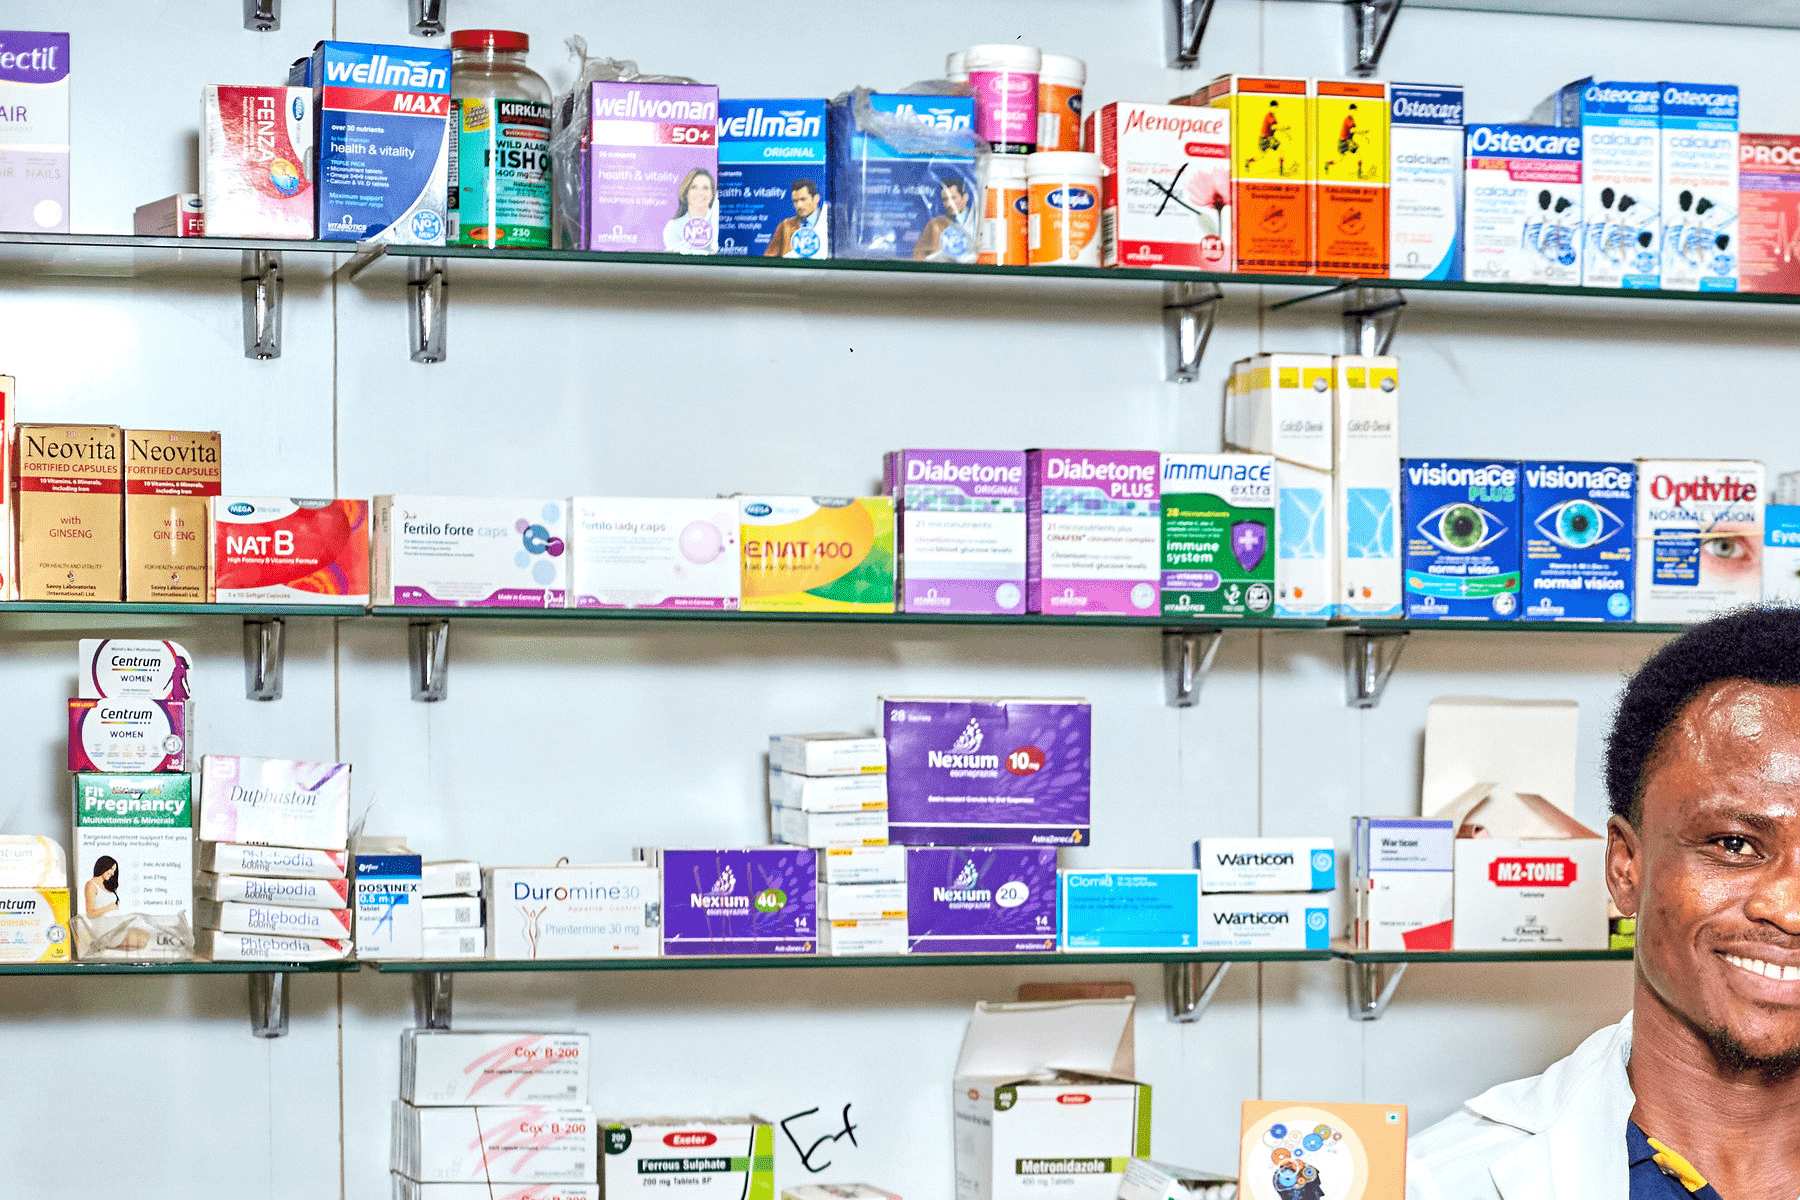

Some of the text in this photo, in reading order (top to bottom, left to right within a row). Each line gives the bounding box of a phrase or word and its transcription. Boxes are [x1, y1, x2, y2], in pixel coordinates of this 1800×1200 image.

[327, 54, 447, 90] wellman
[393, 92, 444, 114] MAX
[1663, 87, 1738, 107] Osteocare
[501, 103, 553, 118] KIRKLAN
[594, 91, 716, 121] wellwoman
[1393, 98, 1462, 121] Osteocare
[258, 95, 276, 162] FENZA
[1124, 109, 1223, 136] Menopace
[671, 127, 711, 143] 50+
[1471, 126, 1580, 157] Osteocare
[330, 140, 415, 160] health & vitality
[497, 140, 521, 150] WILD
[763, 147, 815, 158] ORIGINAL
[1396, 153, 1451, 168] calcium
[26, 435, 116, 463] Neovita
[131, 438, 217, 465] Neovita
[23, 463, 118, 475] FORTIFIED CAPSULES
[127, 465, 220, 478] FORTIFIED CAPSULES
[908, 460, 1022, 484] Diabetone
[1047, 458, 1156, 483] Diabetone
[1164, 457, 1271, 483] immunace
[1409, 464, 1516, 487] visionace
[1527, 465, 1632, 489] visionace
[1110, 483, 1154, 499] PLUS
[1230, 482, 1271, 498] extra
[1650, 474, 1757, 505] Optivite
[60, 515, 82, 527] with
[1649, 510, 1755, 523] NORMAL VISION
[49, 528, 93, 540] GINSENG
[153, 529, 196, 541] GINSENG
[403, 521, 508, 540] fertilo forte caps
[226, 530, 294, 556] NAT B
[812, 542, 852, 560] 400
[1166, 541, 1219, 554] immune
[1166, 551, 1214, 567] system
[1428, 563, 1500, 576] normal vision
[1533, 577, 1625, 591] normal vision
[111, 655, 161, 669] Centrum
[120, 675, 153, 683] WOMEN
[100, 708, 153, 722] Centrum
[109, 730, 144, 739] WOMEN
[84, 797, 187, 817] Pregnancy
[1216, 850, 1295, 869] Warticon
[1498, 863, 1565, 882] M2-TONE
[245, 881, 317, 898] Phlebodia
[358, 883, 418, 893] DOSTINEX
[514, 881, 640, 901] Duromine 30
[933, 886, 991, 905] Nexium
[1212, 910, 1290, 927] Warticon
[642, 1158, 726, 1171] Ferrous Sulphate
[1021, 1159, 1106, 1174] Metronidazole
